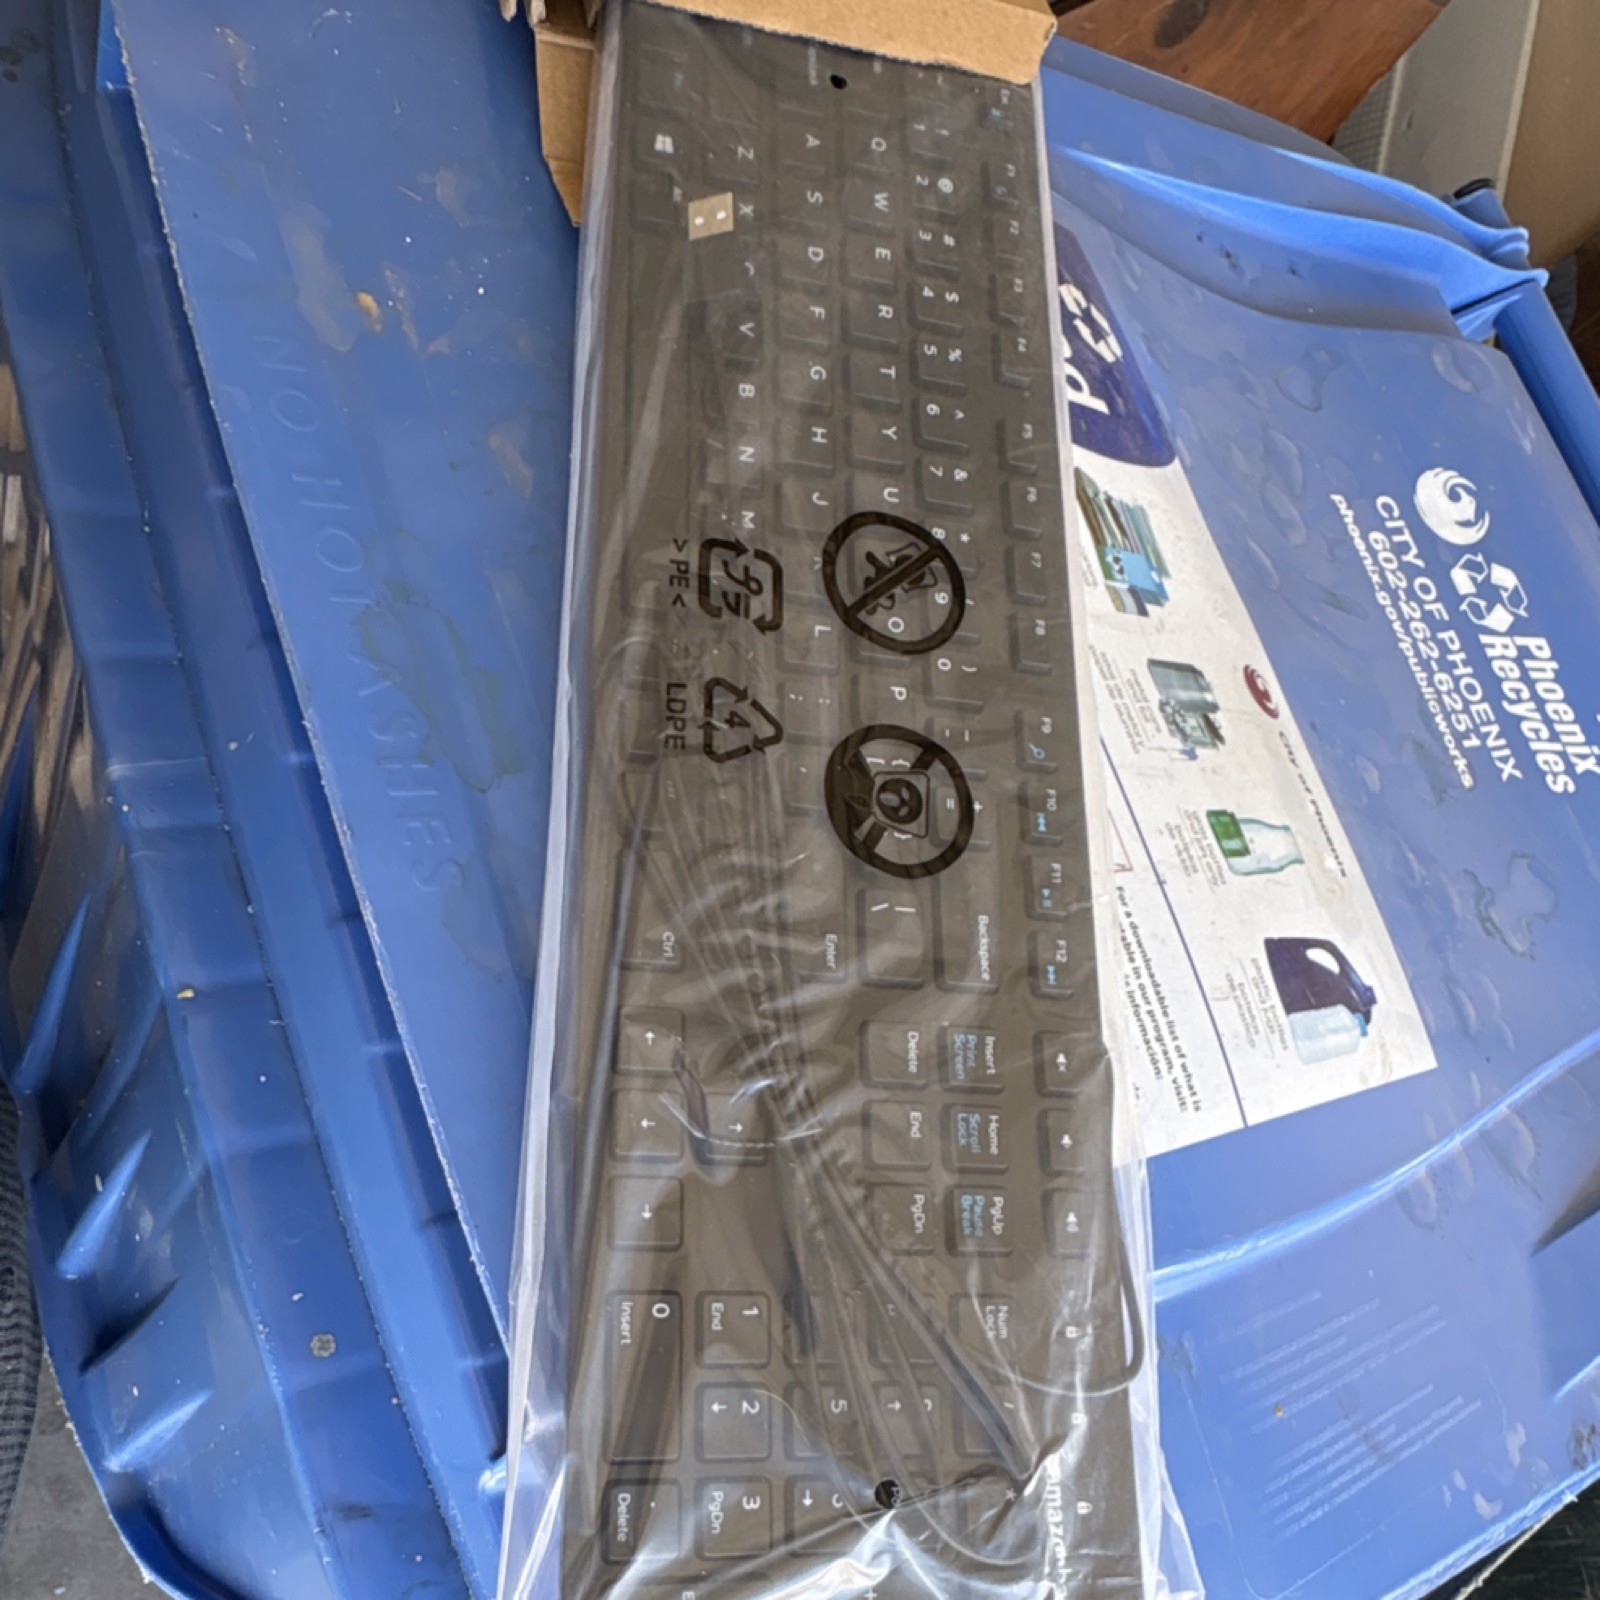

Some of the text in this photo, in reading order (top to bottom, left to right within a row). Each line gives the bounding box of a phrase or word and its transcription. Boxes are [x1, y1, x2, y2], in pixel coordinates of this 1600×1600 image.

[806, 133, 821, 147] A
[871, 137, 887, 152] Q
[737, 145, 754, 160] Z
[1006, 163, 1016, 177] F1
[915, 174, 929, 186] 2
[806, 190, 824, 204] S
[874, 192, 889, 212] W
[918, 229, 933, 241] 3
[1010, 220, 1020, 235] F2
[807, 246, 825, 263] D
[875, 246, 892, 261] E
[922, 285, 935, 298] 4
[1013, 277, 1024, 293] F3
[809, 305, 825, 319] F
[878, 304, 894, 319] R
[739, 322, 755, 337] V
[923, 343, 938, 355] 5
[1017, 337, 1027, 352] F4
[809, 365, 827, 381] G
[880, 365, 896, 379] T
[739, 383, 756, 398] B
[926, 403, 941, 415] 6
[812, 426, 828, 443] H
[882, 426, 898, 440] Y
[1023, 423, 1033, 439] F5
[739, 446, 755, 462] N
[929, 465, 944, 477] 7
[812, 491, 829, 506] J
[883, 486, 900, 503] U
[1026, 486, 1038, 503] F6
[741, 510, 755, 529] M
[1031, 551, 1042, 568] F7
[670, 559, 690, 588] PE
[934, 592, 949, 605] 9
[814, 624, 832, 637] L
[887, 616, 905, 633] O
[1035, 618, 1046, 636] F8
[1329, 492, 1475, 790] phoenix.gov/publicworks
[1367, 530, 1482, 749] 602-262-6251
[1375, 494, 1524, 782] CITY OF PHOENIX
[937, 657, 952, 671] 0
[890, 686, 907, 701] P
[1478, 632, 1577, 794] Recycles
[1512, 635, 1600, 776] Phoenix
[664, 683, 688, 750] LDPE
[725, 711, 750, 728] 4
[1041, 716, 1052, 734] F9
[1046, 788, 1057, 811] F10
[1051, 862, 1062, 883] F11
[661, 930, 676, 958] Ctrl
[824, 933, 838, 970] Enter
[977, 914, 991, 981] Backspace
[1055, 939, 1068, 963] F12
[1129, 920, 1168, 1018] downloadable
[1138, 982, 1152, 1007] our
[1146, 1008, 1174, 1075] program,
[1166, 1019, 1179, 1042] list
[907, 1030, 920, 1073] Delete
[953, 1032, 966, 1080] Screen
[966, 1034, 978, 1067] Print
[984, 1035, 997, 1075] Insert
[1174, 1044, 1187, 1059] of
[1180, 1061, 1198, 1097] what
[1193, 1099, 1201, 1112] is
[909, 1111, 923, 1138] End
[957, 1112, 968, 1146] Lock
[968, 1113, 981, 1153] Scroll
[988, 1114, 999, 1156] Home
[910, 1193, 926, 1234] PgDn
[989, 1196, 1004, 1235] PgUp
[651, 1302, 671, 1319] 0
[711, 1302, 725, 1331] End
[742, 1307, 759, 1315] 1
[620, 1301, 634, 1344] Insert
[997, 1305, 1009, 1339] Num
[741, 1400, 760, 1415] 2
[830, 1399, 848, 1414] 5
[742, 1495, 761, 1510] 3
[617, 1492, 632, 1542] Delete
[707, 1490, 725, 1534] PgDn
